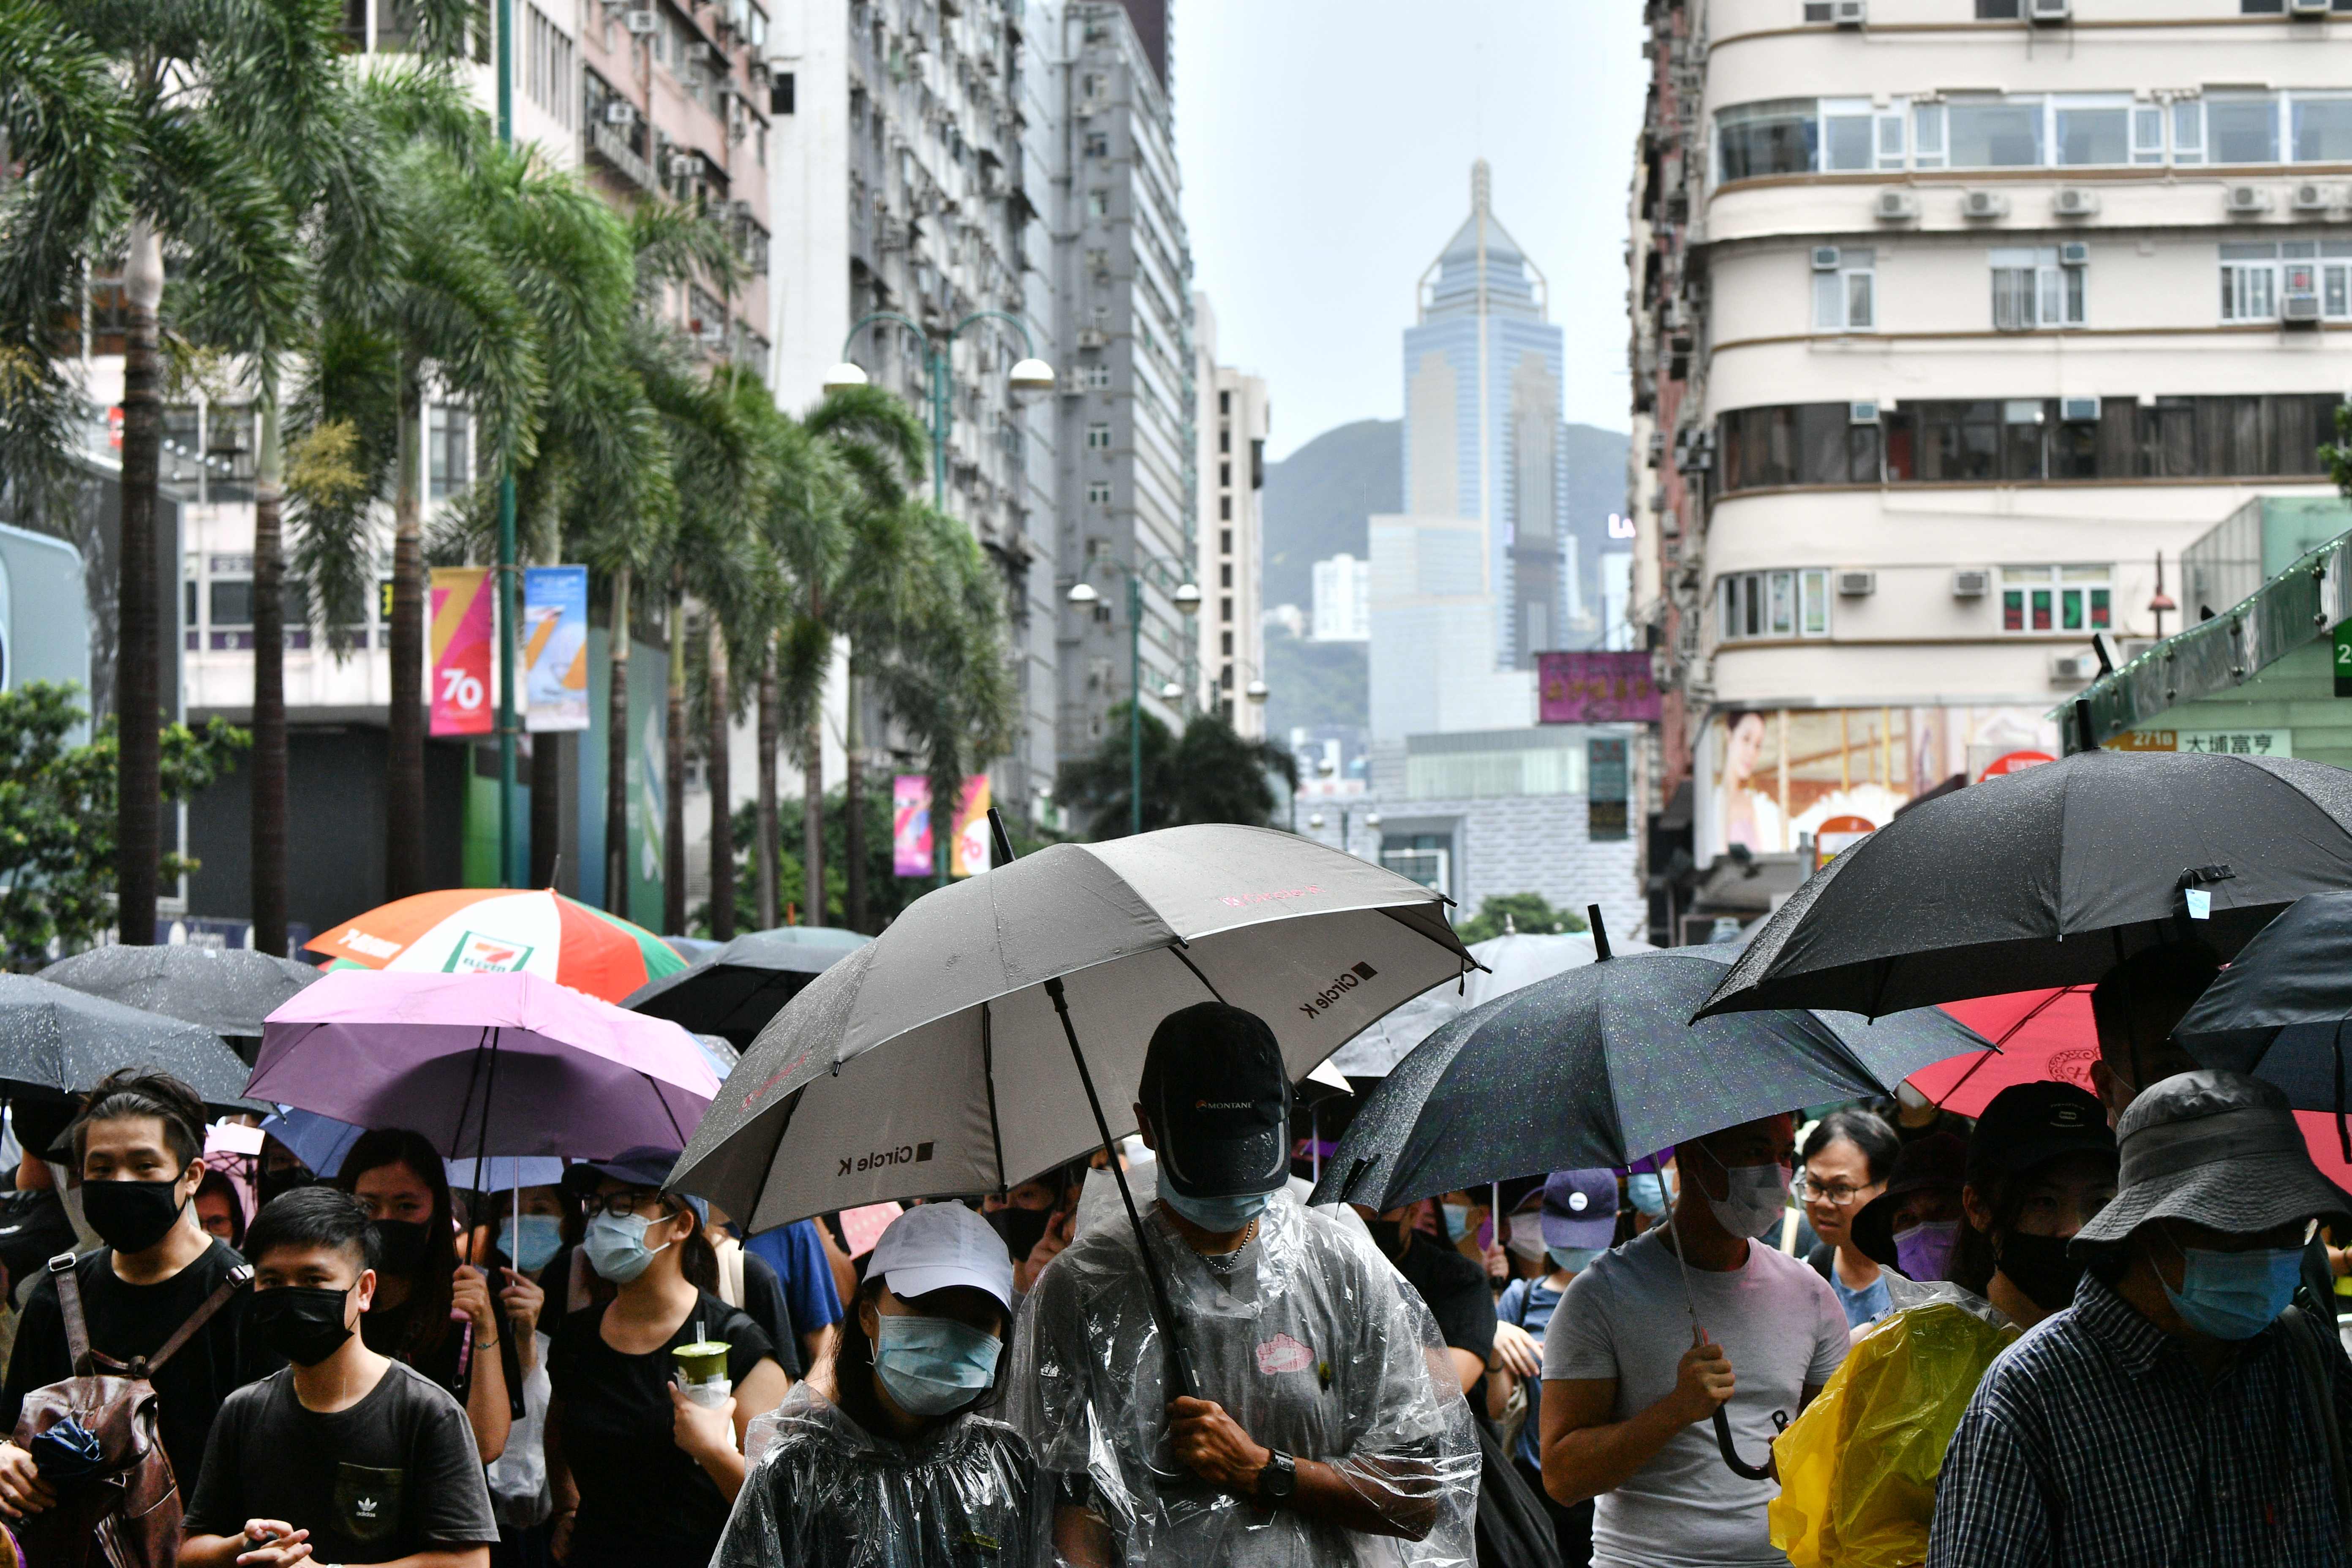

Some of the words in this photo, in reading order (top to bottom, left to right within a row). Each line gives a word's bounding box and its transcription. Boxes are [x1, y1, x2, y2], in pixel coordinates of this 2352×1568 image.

[2338, 643, 2352, 663] 2
[441, 669, 483, 710] 70
[2185, 734, 2273, 754] 大埔富亨
